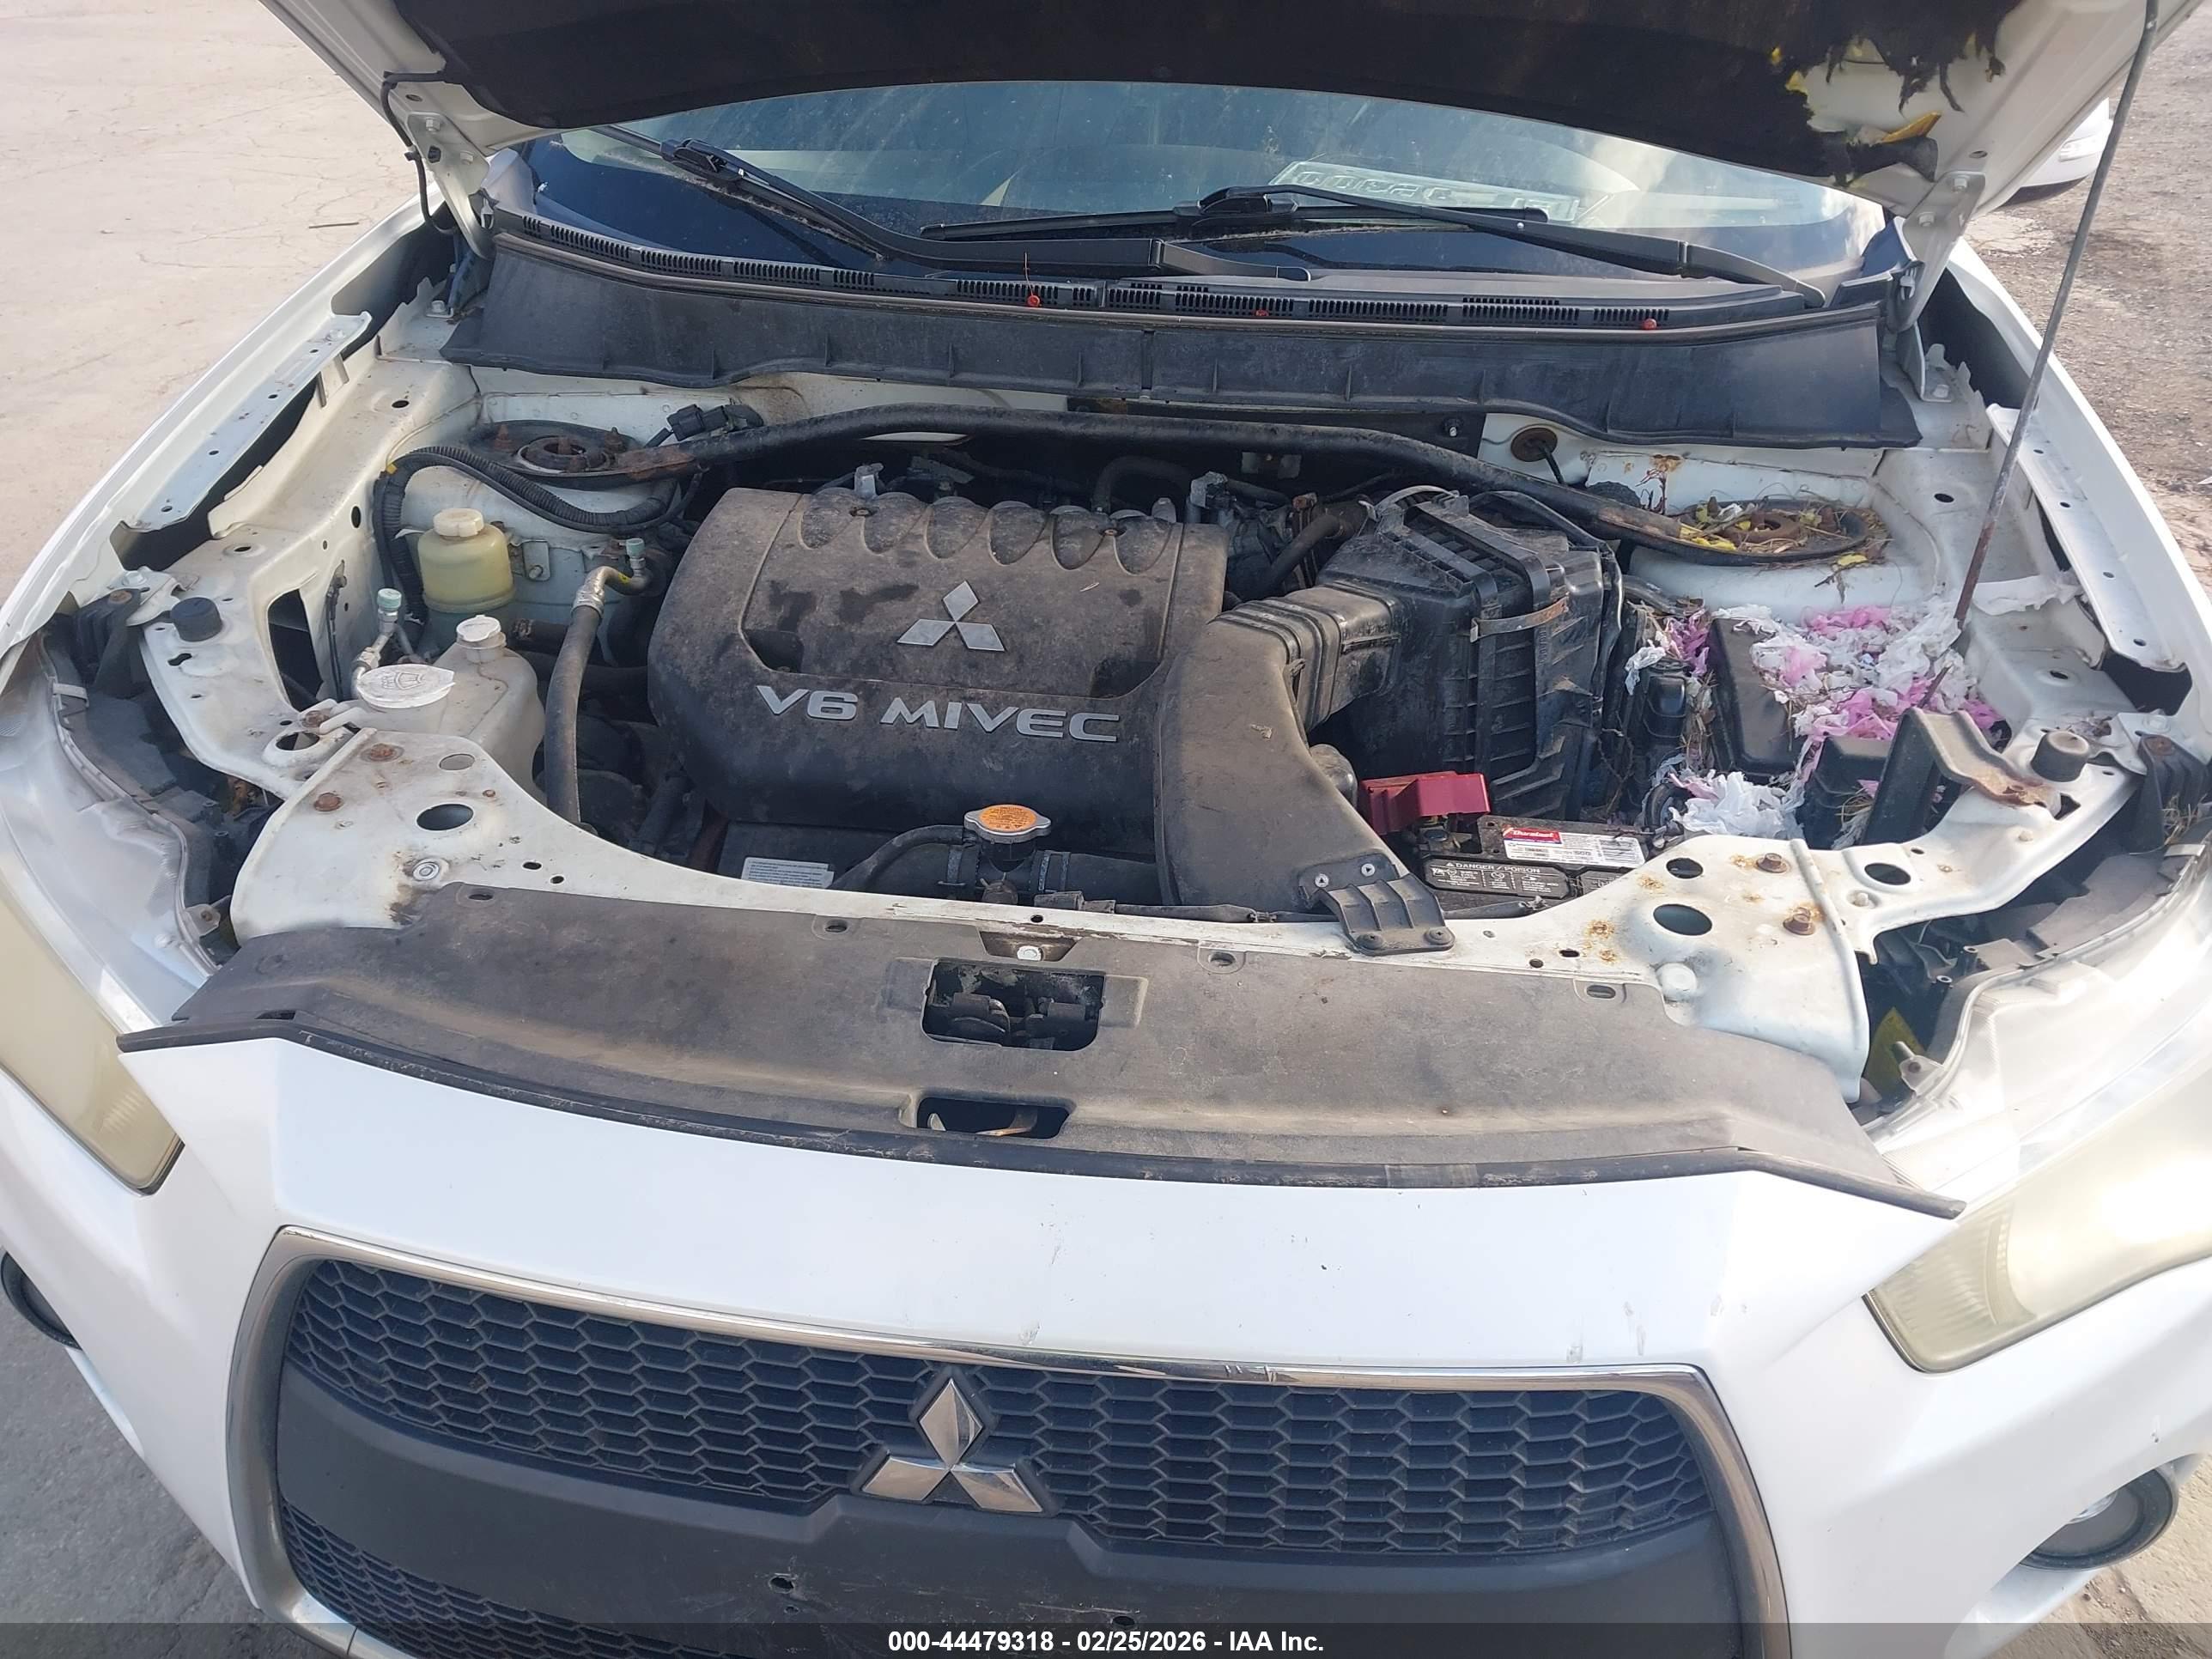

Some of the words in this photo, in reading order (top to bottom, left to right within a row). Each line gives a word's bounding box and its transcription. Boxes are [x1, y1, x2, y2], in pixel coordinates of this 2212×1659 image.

[757, 685, 858, 720] V6
[879, 697, 1120, 742] MIVEC
[1455, 862, 1494, 871] DANGER
